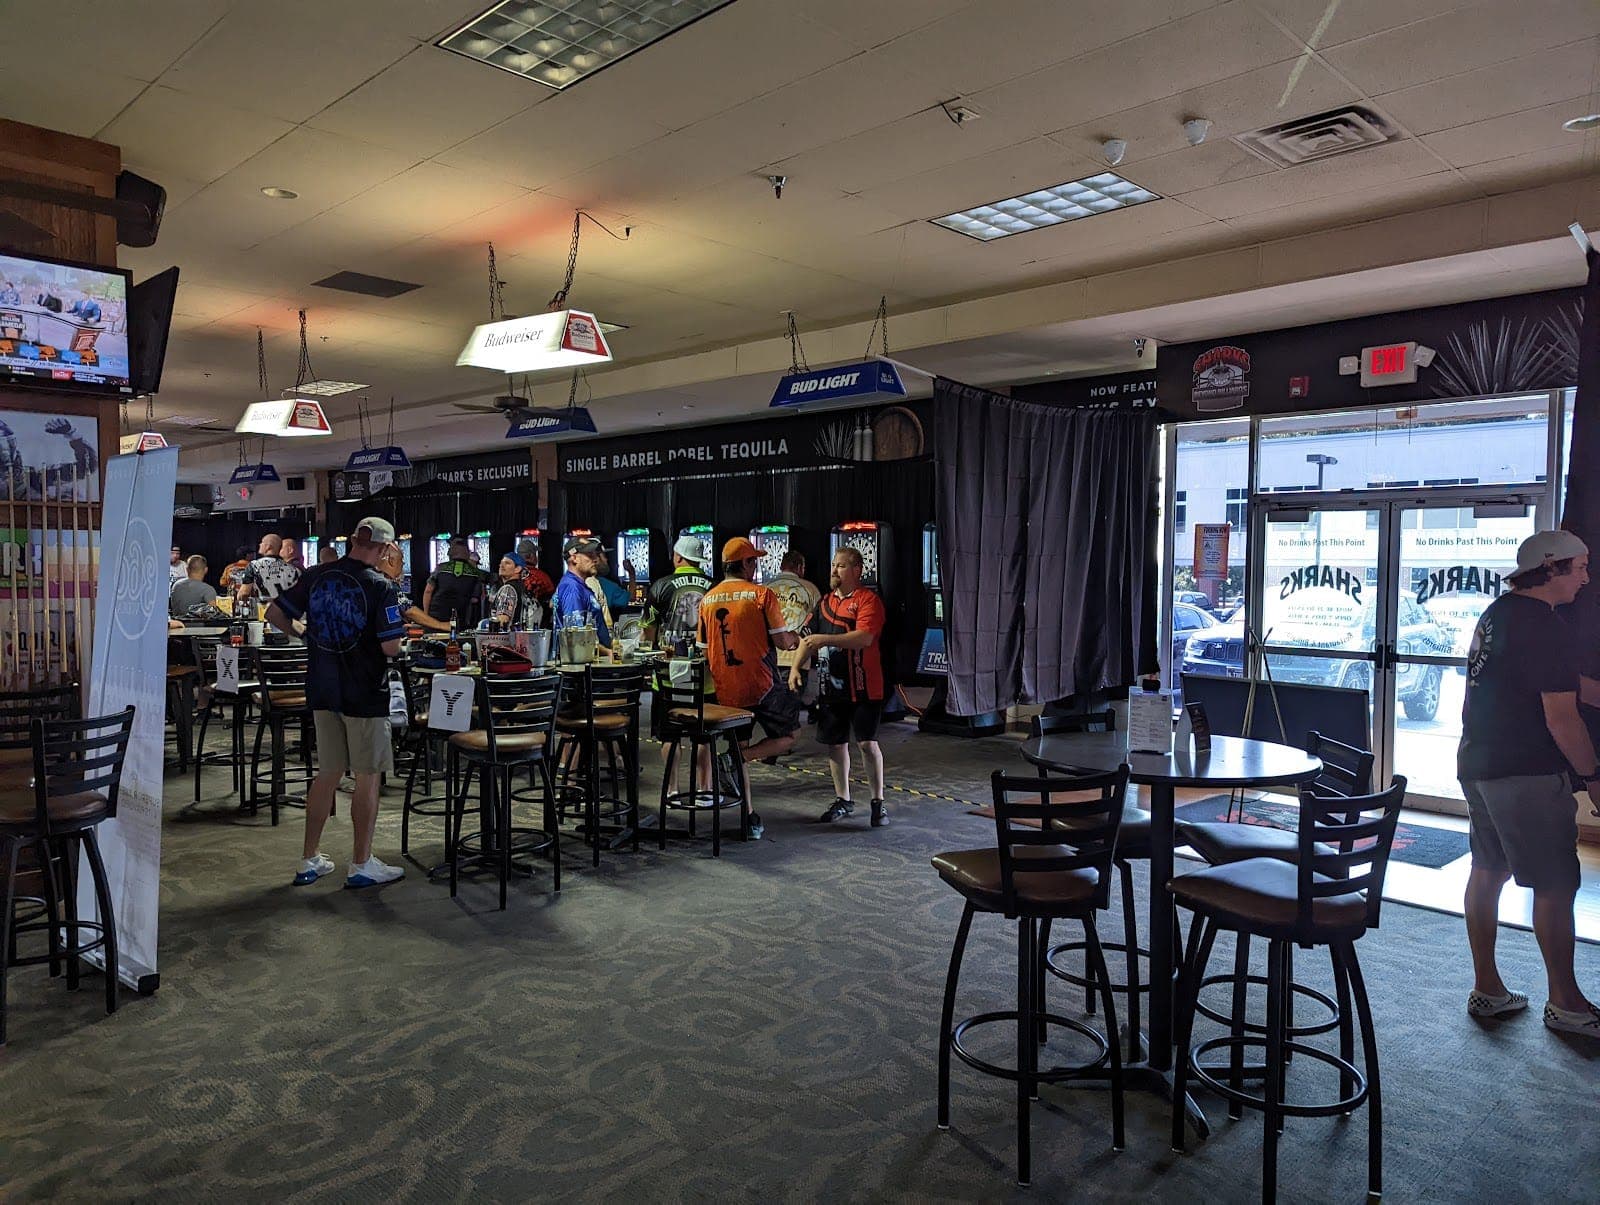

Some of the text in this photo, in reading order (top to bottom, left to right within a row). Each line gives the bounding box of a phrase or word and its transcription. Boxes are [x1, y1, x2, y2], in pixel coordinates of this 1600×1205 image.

[484, 327, 545, 349] Budweiser
[1371, 346, 1407, 376] EXIT
[790, 372, 861, 395] BUD LIGHT
[1090, 385, 1118, 397] NOW
[566, 456, 607, 473] SINGLE
[612, 450, 662, 469] BARREL
[721, 438, 789, 459] TEQUILA
[477, 463, 529, 481] EXCLUSIVE
[1278, 538, 1366, 547] No Drinks Past This Point
[1415, 537, 1518, 546] No Drinks Past This Point
[671, 575, 712, 590] HOLDEN
[221, 658, 234, 680] X
[440, 689, 465, 716] Y
